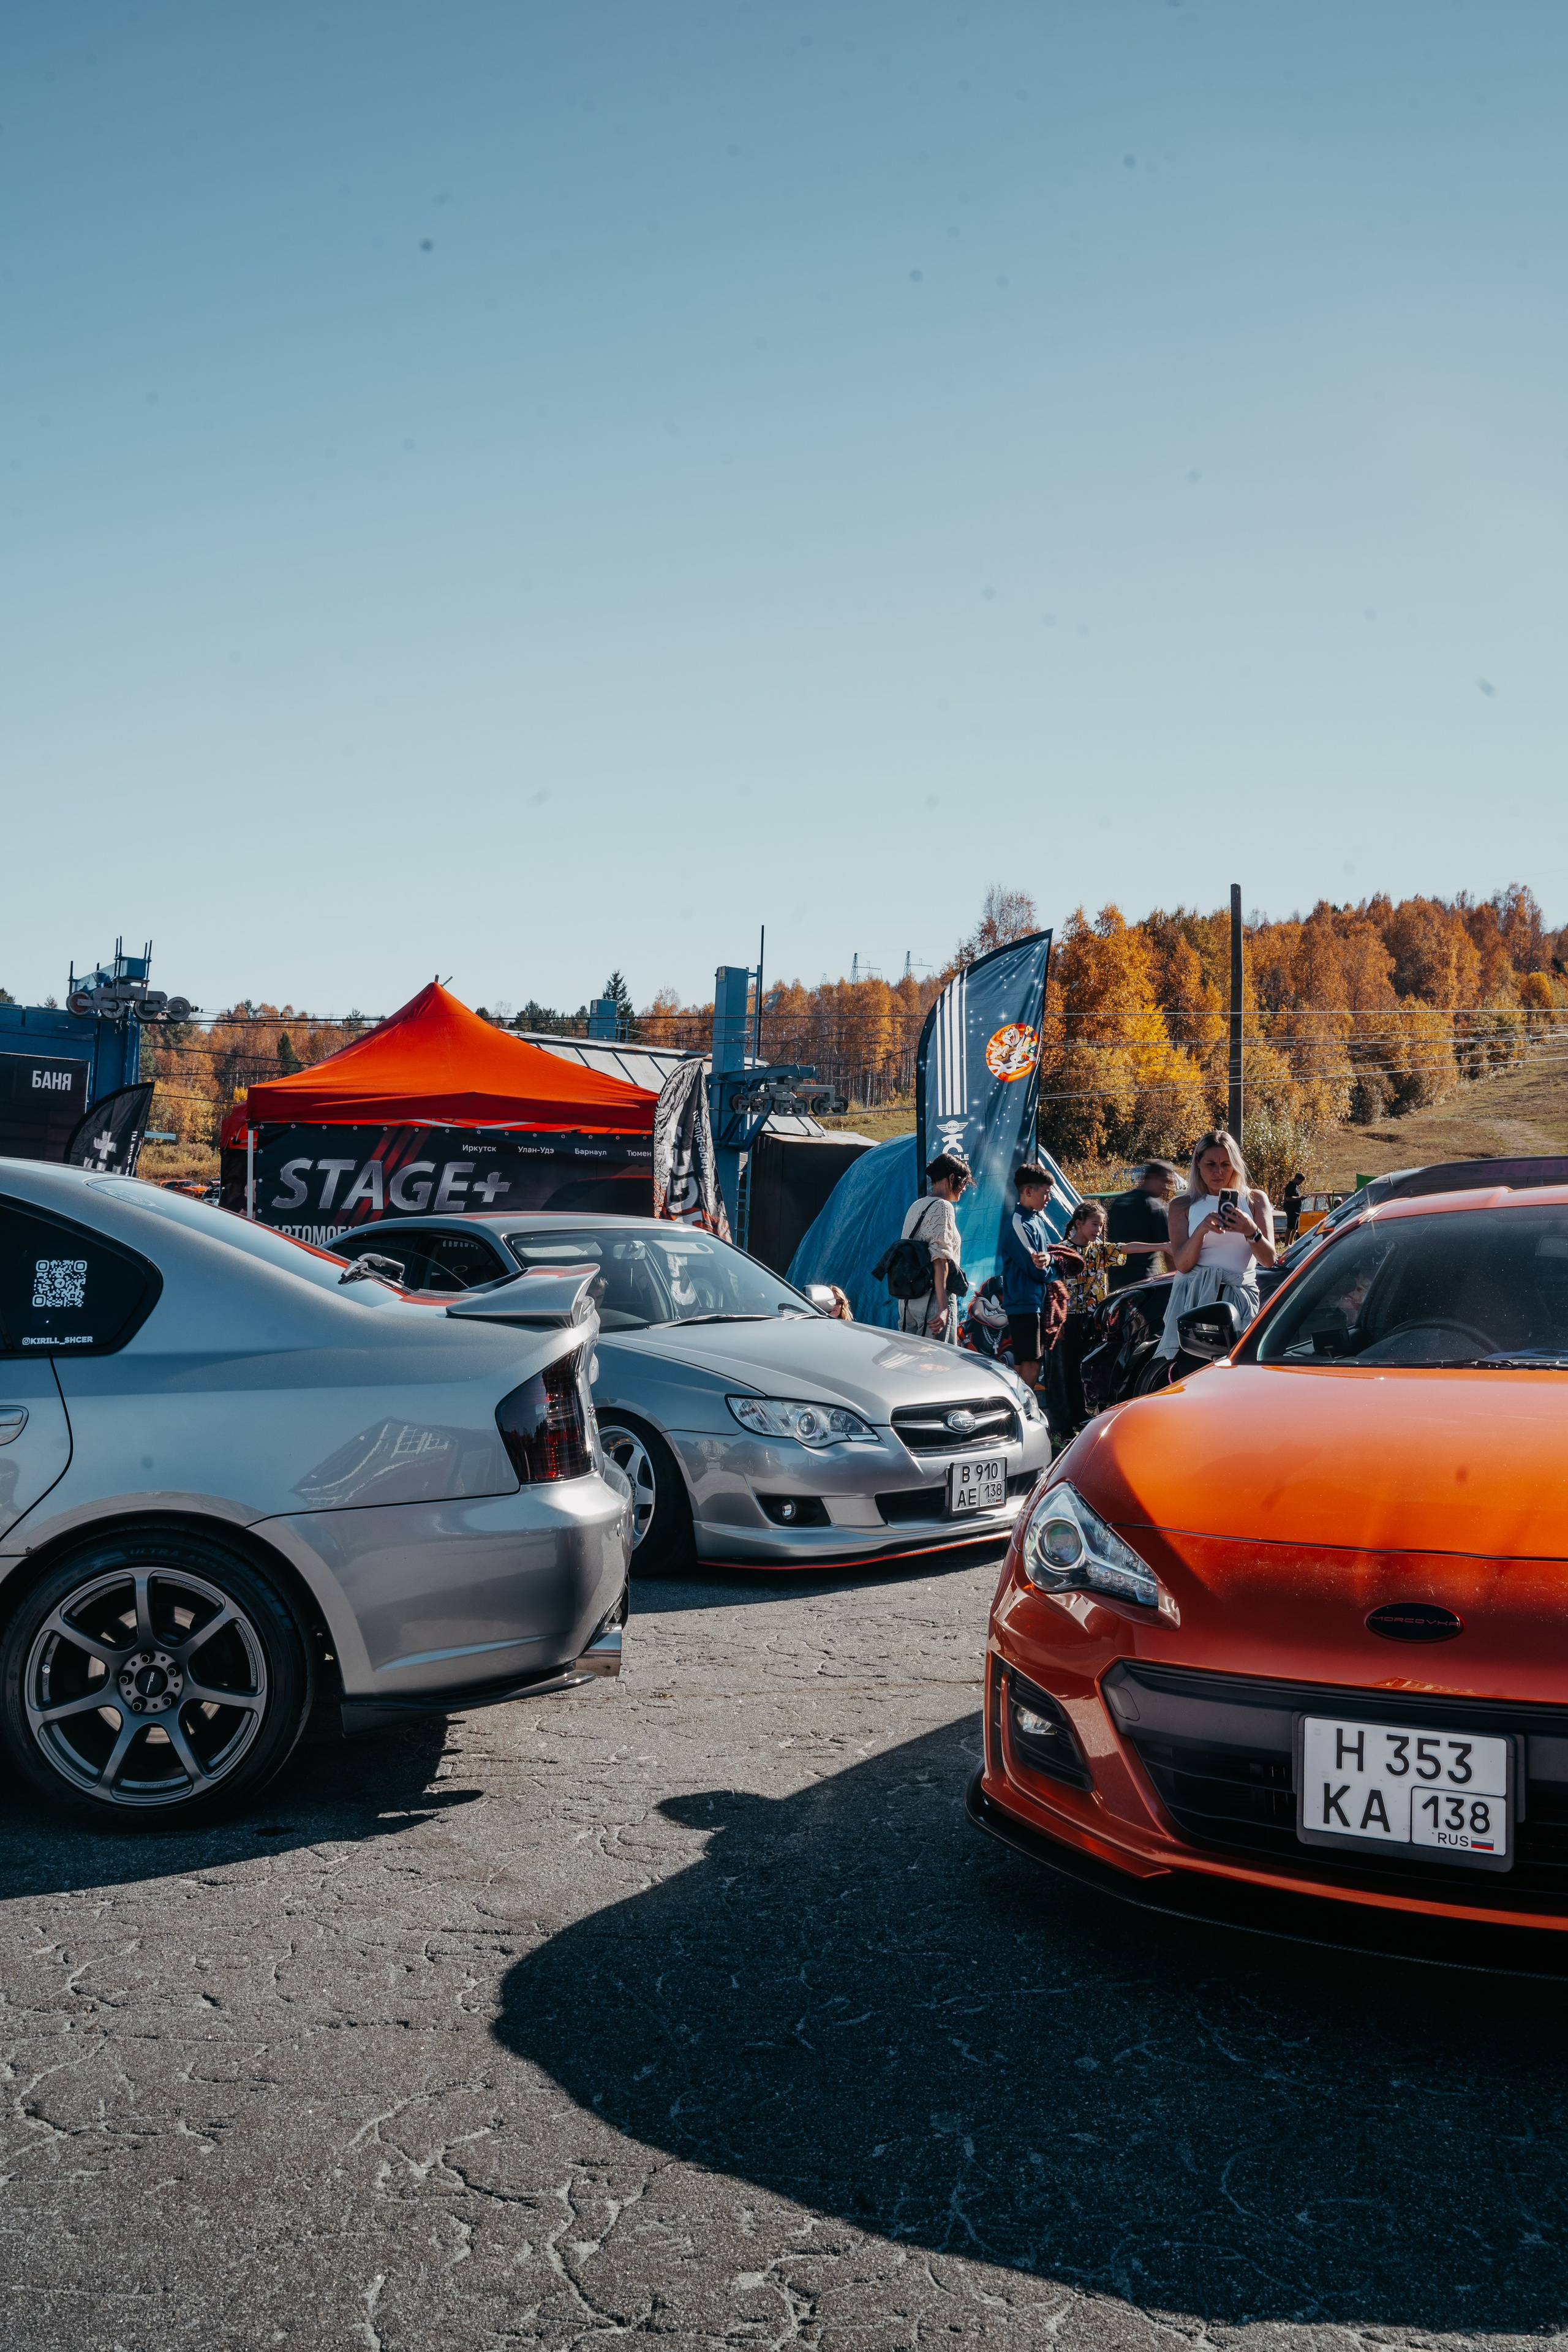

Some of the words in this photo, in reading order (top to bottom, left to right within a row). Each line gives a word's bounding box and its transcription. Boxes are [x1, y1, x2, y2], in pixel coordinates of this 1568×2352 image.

[32, 1070, 72, 1090] БАНЯ
[462, 1144, 497, 1153] Иркутск
[692, 1110, 712, 1205] www.stage-plus.ru
[271, 1157, 511, 1212] STAGE+
[962, 1466, 970, 1483] B
[976, 1462, 998, 1481] 910
[957, 1488, 977, 1507] AE
[984, 1483, 1002, 1498] 138
[129, 1548, 180, 1557] ULTRA
[1370, 1616, 1459, 1627] MORCOVKA
[1335, 1728, 1365, 1772] H
[1385, 1734, 1472, 1784] 353
[1323, 1782, 1391, 1833] KA
[1421, 1795, 1490, 1834] 138
[1437, 1832, 1469, 1847] RUS
